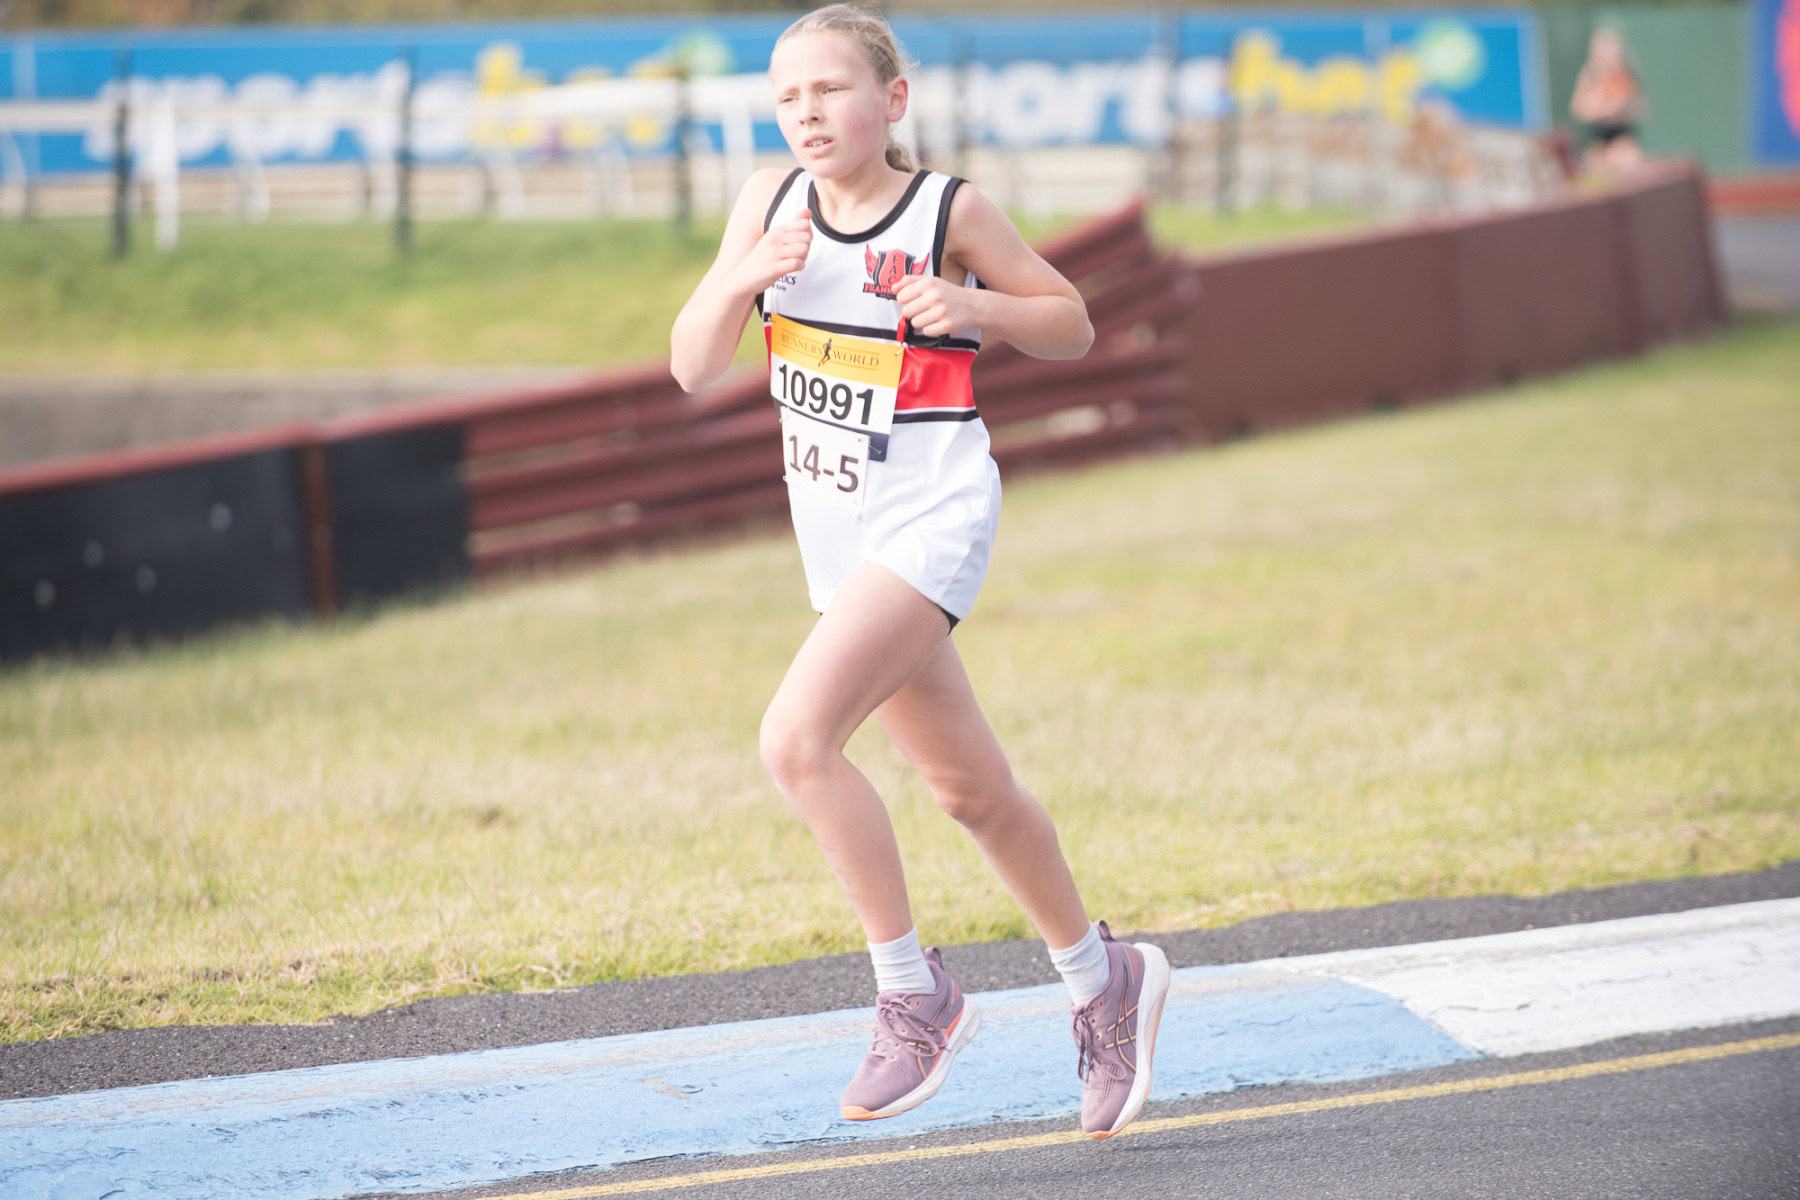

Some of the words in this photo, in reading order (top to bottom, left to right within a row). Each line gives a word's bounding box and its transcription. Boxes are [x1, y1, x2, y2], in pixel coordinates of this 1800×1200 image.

[781, 332, 823, 356] RUNNERS
[833, 348, 880, 367] WORLD
[779, 364, 874, 425] 10991
[789, 435, 859, 493] 14-5
